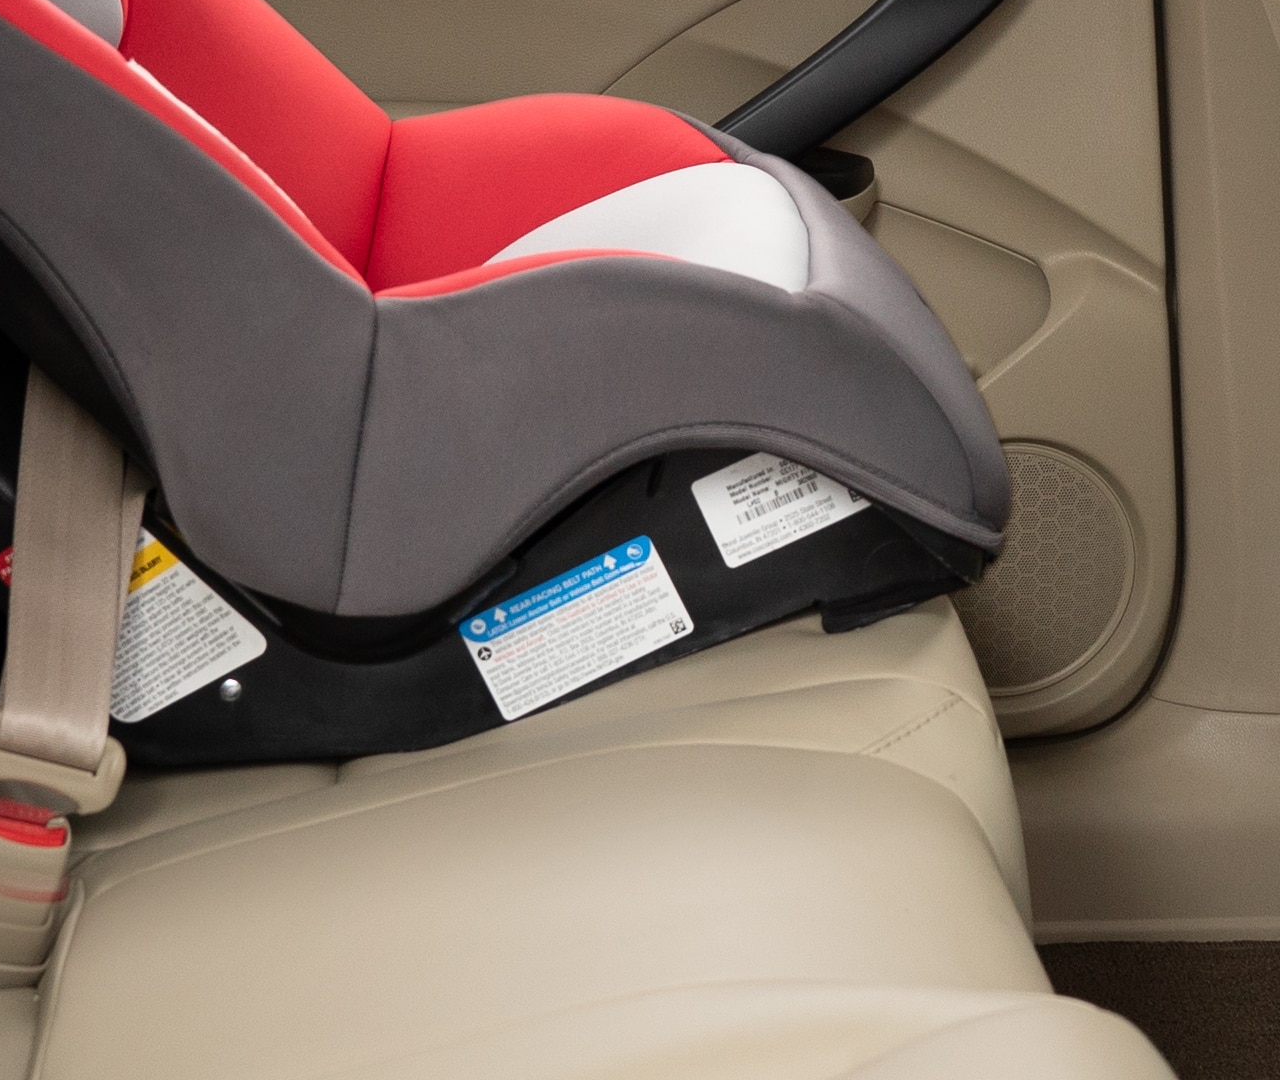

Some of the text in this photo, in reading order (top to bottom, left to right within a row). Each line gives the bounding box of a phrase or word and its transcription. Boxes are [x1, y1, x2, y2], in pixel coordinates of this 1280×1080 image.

[508, 563, 603, 615] REAR-FACING BELT PATH
